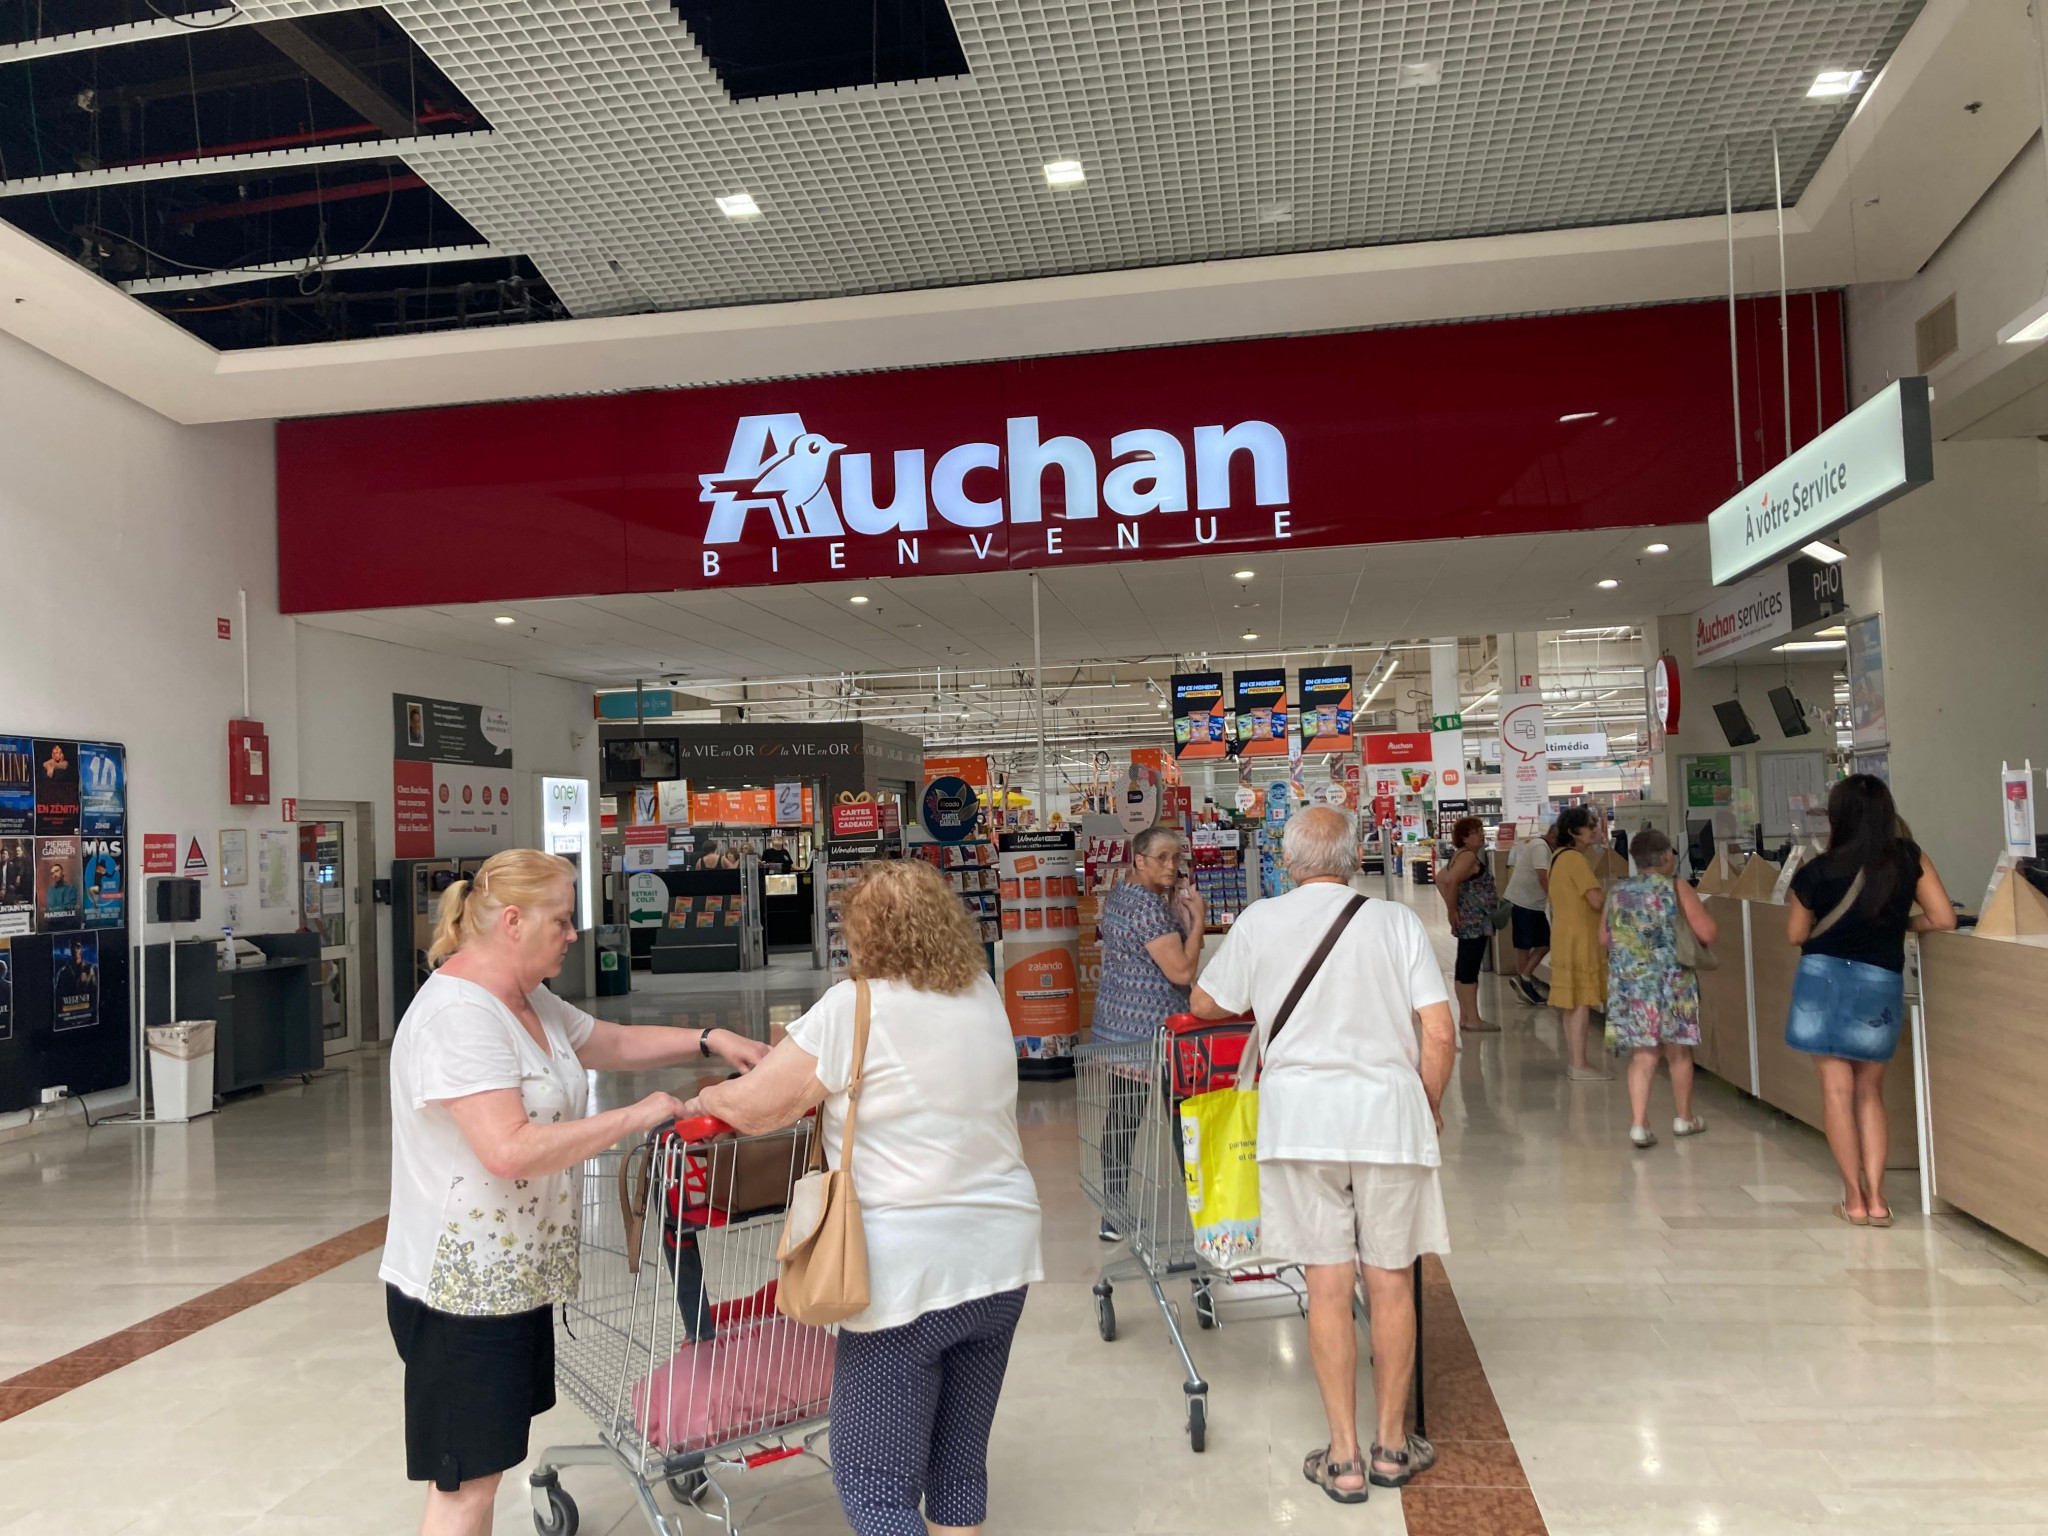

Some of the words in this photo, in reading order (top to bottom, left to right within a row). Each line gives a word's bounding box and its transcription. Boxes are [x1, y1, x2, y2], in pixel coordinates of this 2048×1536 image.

[699, 412, 1290, 545] Auchan
[1745, 505, 1755, 546] À
[1792, 460, 1847, 518] Service
[702, 511, 1291, 577] BIENVENUE
[1813, 564, 1841, 600] PHO
[1697, 614, 1736, 648] Auchan
[1737, 591, 1783, 630] services
[681, 748, 691, 758] la
[694, 744, 719, 757] VIE
[721, 749, 731, 757] en
[733, 744, 755, 757] OR
[780, 747, 789, 756] la
[792, 744, 816, 756] VIE
[829, 743, 850, 755] OR
[1388, 741, 1413, 750] Auchan
[1546, 741, 1589, 752] ltimédia
[0, 752, 29, 782] LINE
[553, 784, 579, 804] oney
[841, 808, 871, 816] CARTES
[839, 820, 873, 828] CADEAUX
[45, 840, 72, 848] PIERRE
[1017, 834, 1044, 843] Wonder
[42, 847, 76, 856] GARNIER
[85, 840, 122, 857] MAS
[831, 845, 857, 854] Wonder
[0, 904, 19, 912] UNTAIN
[20, 903, 34, 911] MEN
[1028, 962, 1063, 972] zalando
[1229, 1140, 1257, 1150] partenai
